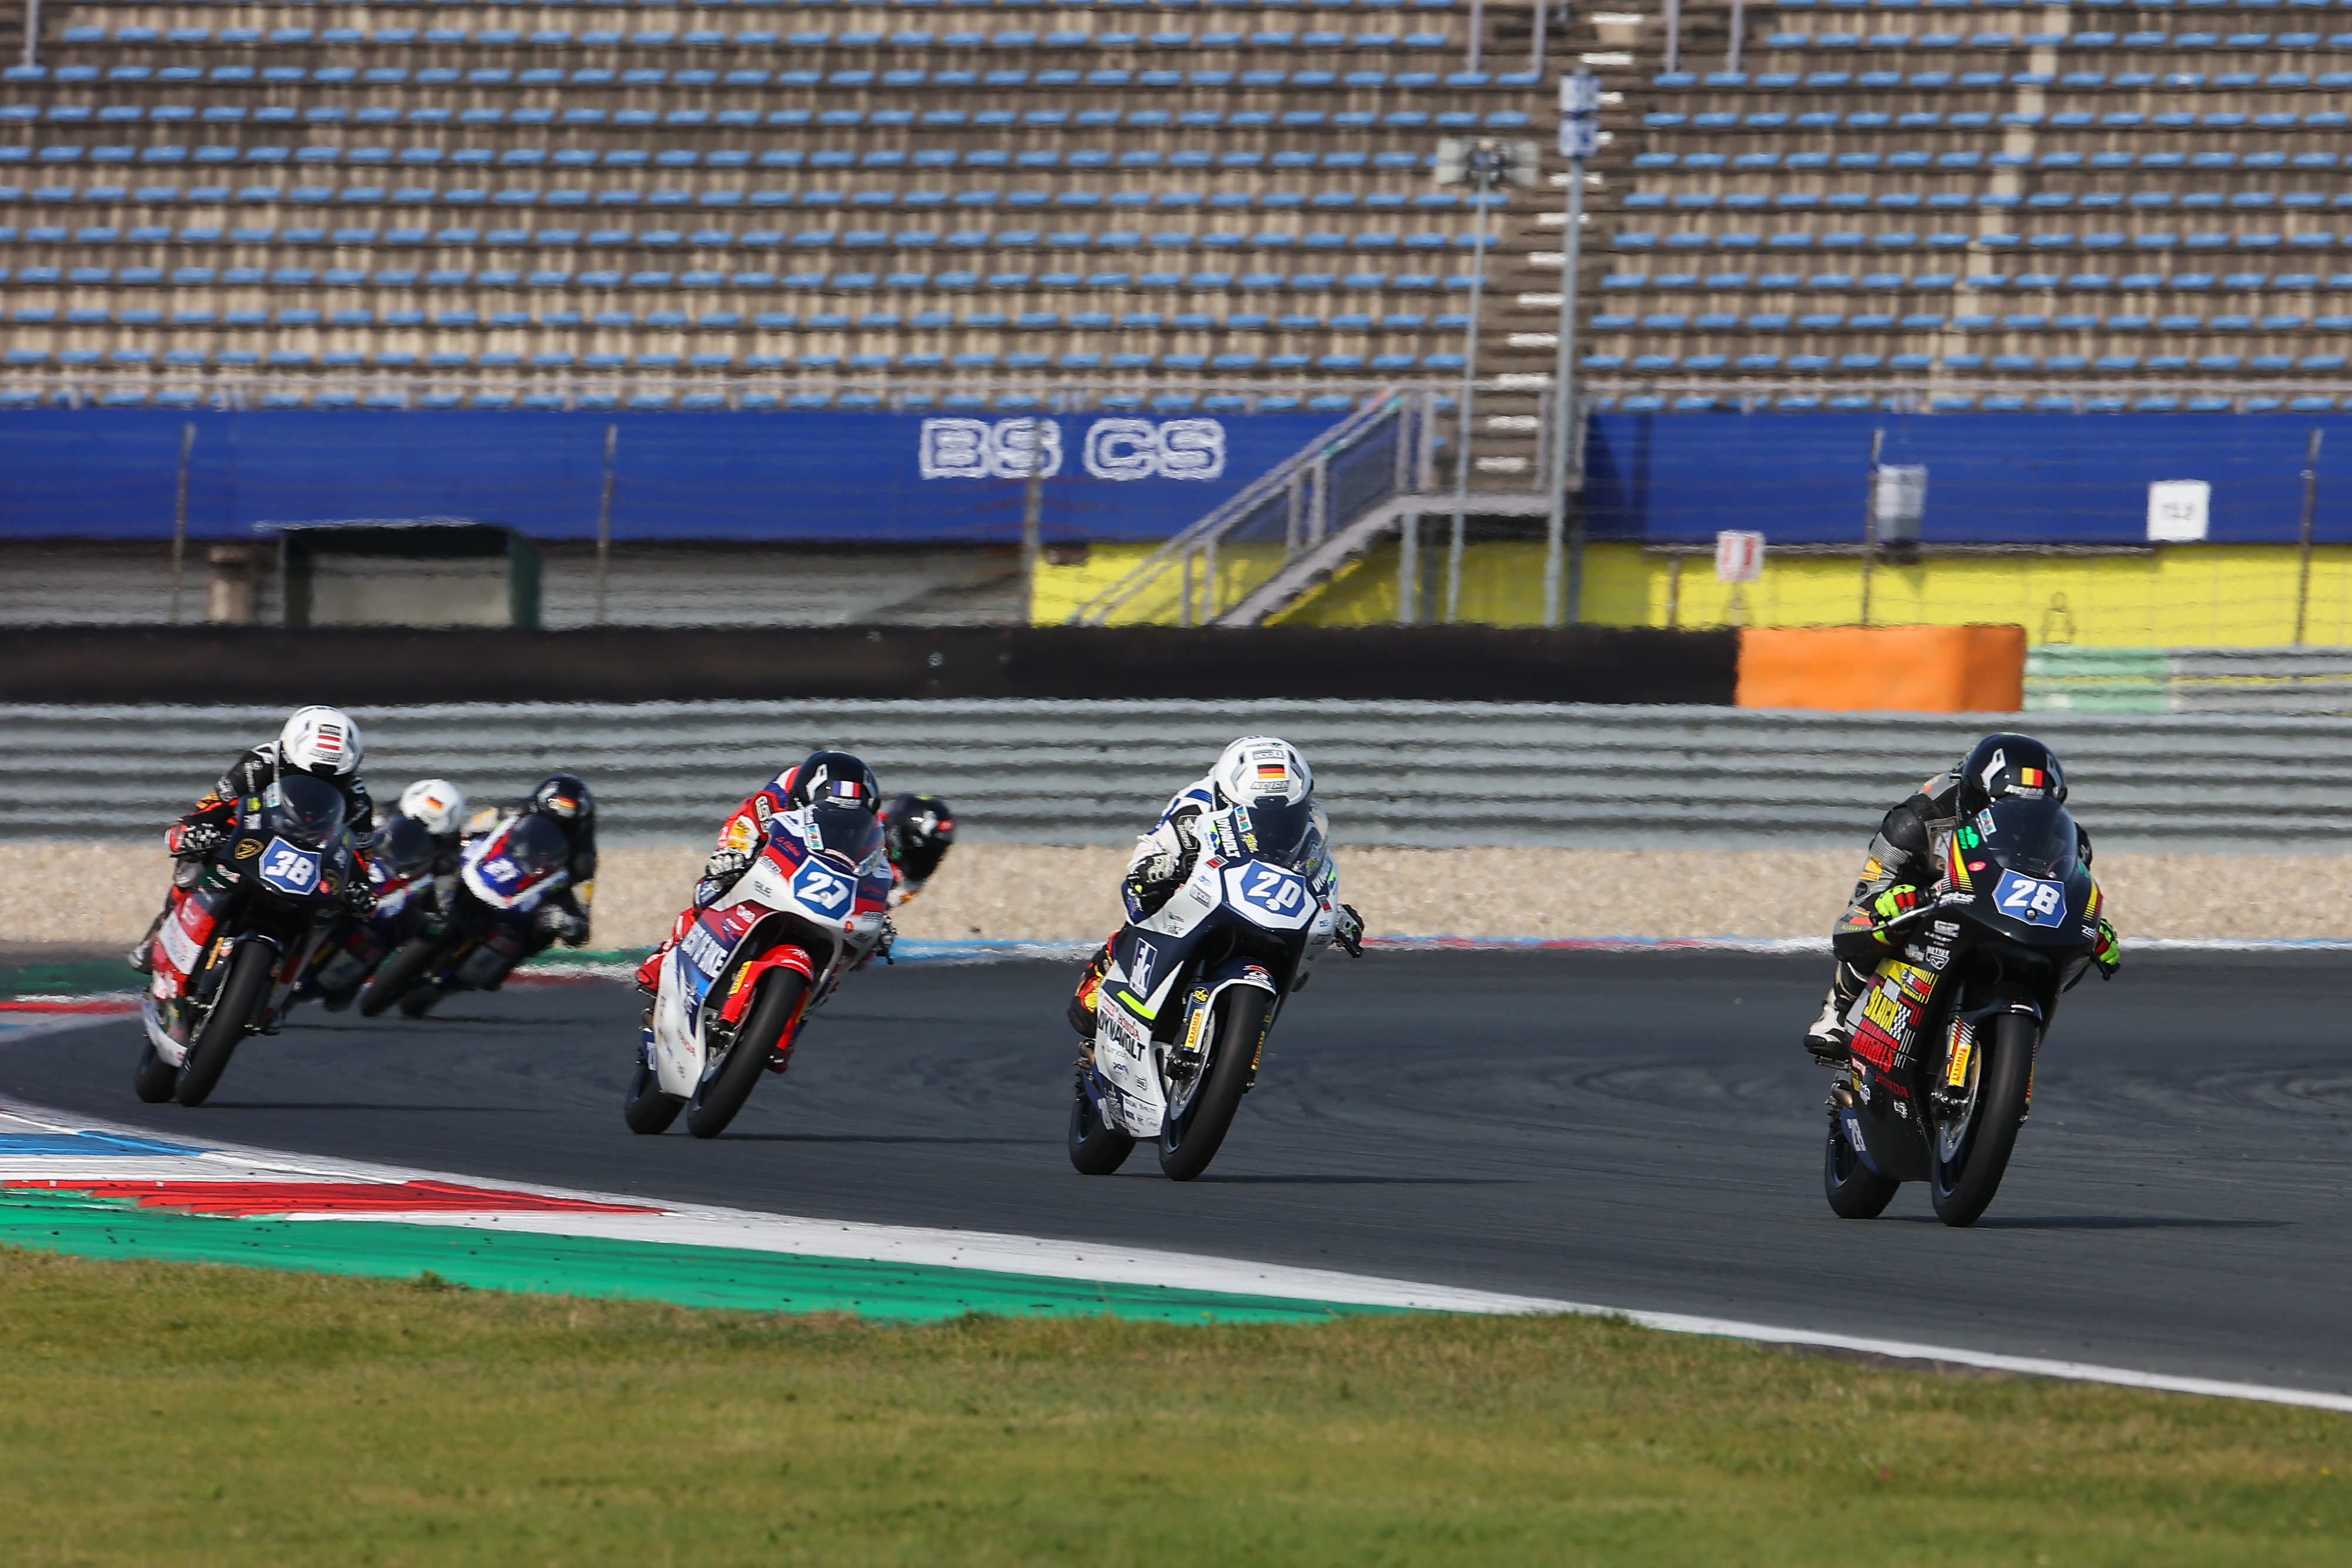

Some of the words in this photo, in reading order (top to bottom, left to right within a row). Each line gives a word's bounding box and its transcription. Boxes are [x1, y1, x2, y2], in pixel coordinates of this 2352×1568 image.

[1083, 417, 1227, 481] CS
[1215, 817, 1241, 858] DYNAVOLT
[265, 850, 316, 886] 38
[796, 871, 850, 910] 27
[1247, 871, 1302, 909] 20
[2003, 880, 2060, 915] 28
[1863, 984, 1901, 1032] BLACK
[1097, 1009, 1146, 1062] DYNAVOLT
[1951, 1047, 1967, 1082] PIRELLI
[1874, 1071, 1910, 1098] HONDA
